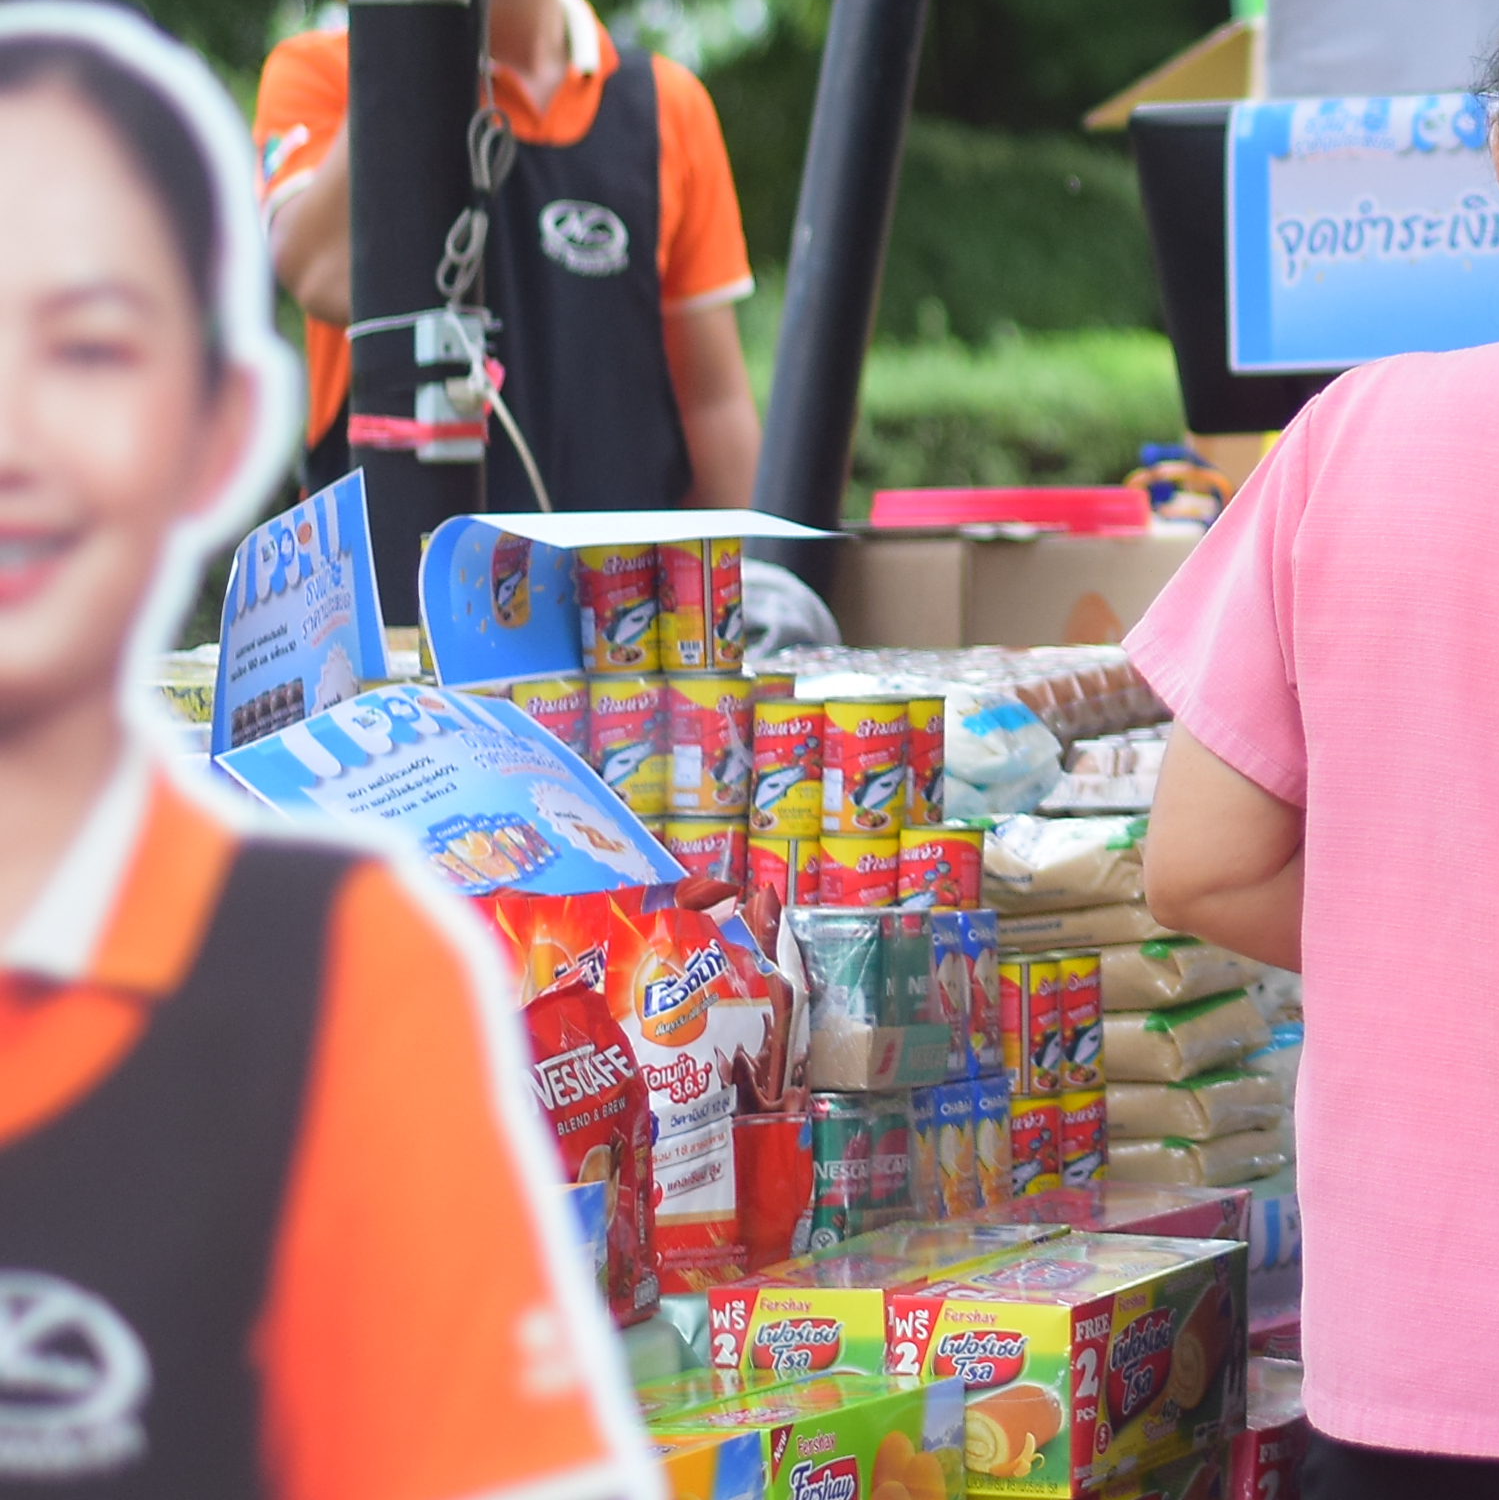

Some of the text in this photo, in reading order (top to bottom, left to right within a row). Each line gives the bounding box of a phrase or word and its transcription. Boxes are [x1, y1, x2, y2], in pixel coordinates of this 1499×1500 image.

[642, 1053, 695, 1089] โอเมก้า
[557, 1096, 626, 1136] BLEND & BREW
[712, 1300, 746, 1331] ฟรี
[759, 1297, 811, 1314] Fershay
[944, 1308, 998, 1326] Fershay
[895, 1309, 930, 1340] ฟรี
[1075, 1313, 1110, 1342] FREE
[714, 1333, 739, 1366] 2
[771, 1345, 811, 1369] โรล
[895, 1342, 921, 1375] 2
[954, 1357, 994, 1383] โรล
[1075, 1347, 1099, 1398] 2
[796, 1430, 836, 1458] Fershay
